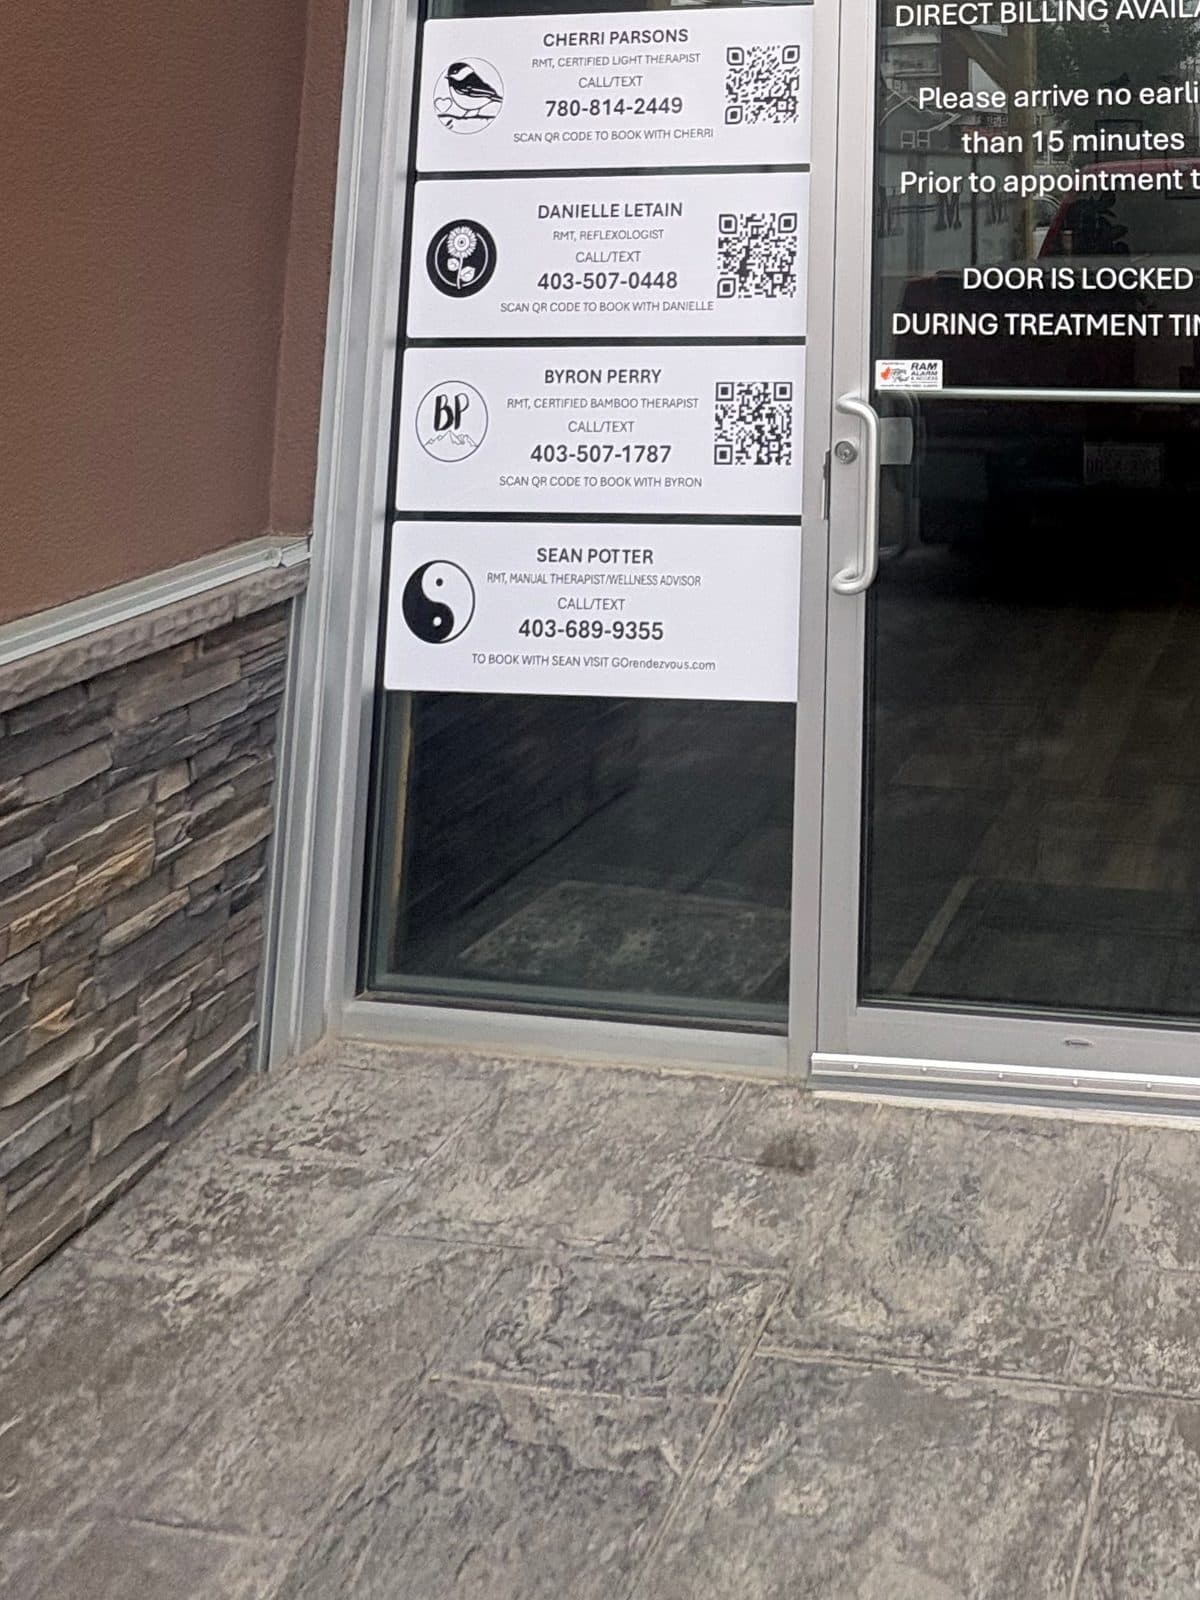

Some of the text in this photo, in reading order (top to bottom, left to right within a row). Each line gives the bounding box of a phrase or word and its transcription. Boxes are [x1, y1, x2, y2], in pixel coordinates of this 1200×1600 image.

[896, 3, 993, 27] DIRECT
[1001, 0, 1108, 23] BILLING
[543, 29, 688, 48] CHERRI PARSONS
[532, 53, 700, 69] RMT, CERTIFIED LIGHT THERAPIST
[579, 75, 642, 89] CALL/TEXT
[919, 87, 1006, 109] Please
[1013, 85, 1088, 107] arrive
[1097, 87, 1131, 105] no
[545, 98, 683, 117] 780-814-2449
[513, 128, 713, 144] SCAN QR CODE TO BOOK WITH CHERRI
[962, 130, 1185, 153] than 15 minutes
[901, 172, 962, 193] Prior
[969, 172, 996, 192] to
[1003, 168, 1183, 196] appointment
[538, 202, 682, 219] DANIELLE LETAIN
[553, 229, 663, 241] RMT, REFLEXOLOGIST
[575, 250, 641, 264] CALL/TEXT
[538, 272, 677, 290] 403-507-0448
[963, 267, 1193, 290] DOOR IS LOCKED
[500, 301, 714, 314] SCAN QR CODE TO BOOK WITH DANIELLE
[892, 313, 998, 334] DURING
[1004, 314, 1163, 336] TREATMENT
[911, 362, 937, 370] RAM
[544, 369, 661, 384] BYRON PERRY
[507, 398, 698, 409] RMT, CERTIFIED BAMBOO THERAPIST
[434, 393, 469, 431] BP
[568, 421, 634, 433] CALL/TEXT
[530, 444, 671, 463] 403-507-1787
[499, 476, 702, 488] SCAN QR CODE TO BOOK WITH BYRON
[537, 548, 654, 564] SEAN POTTER
[487, 573, 701, 586] RMT, MANUAL THERAPIST/WELLNESS ADVISOR
[558, 597, 625, 610] CALL/TEXT
[518, 619, 664, 640] 403-689-9355
[472, 653, 715, 670] TO BOOK WITH SEAN VISIT GOrendezvous.com
